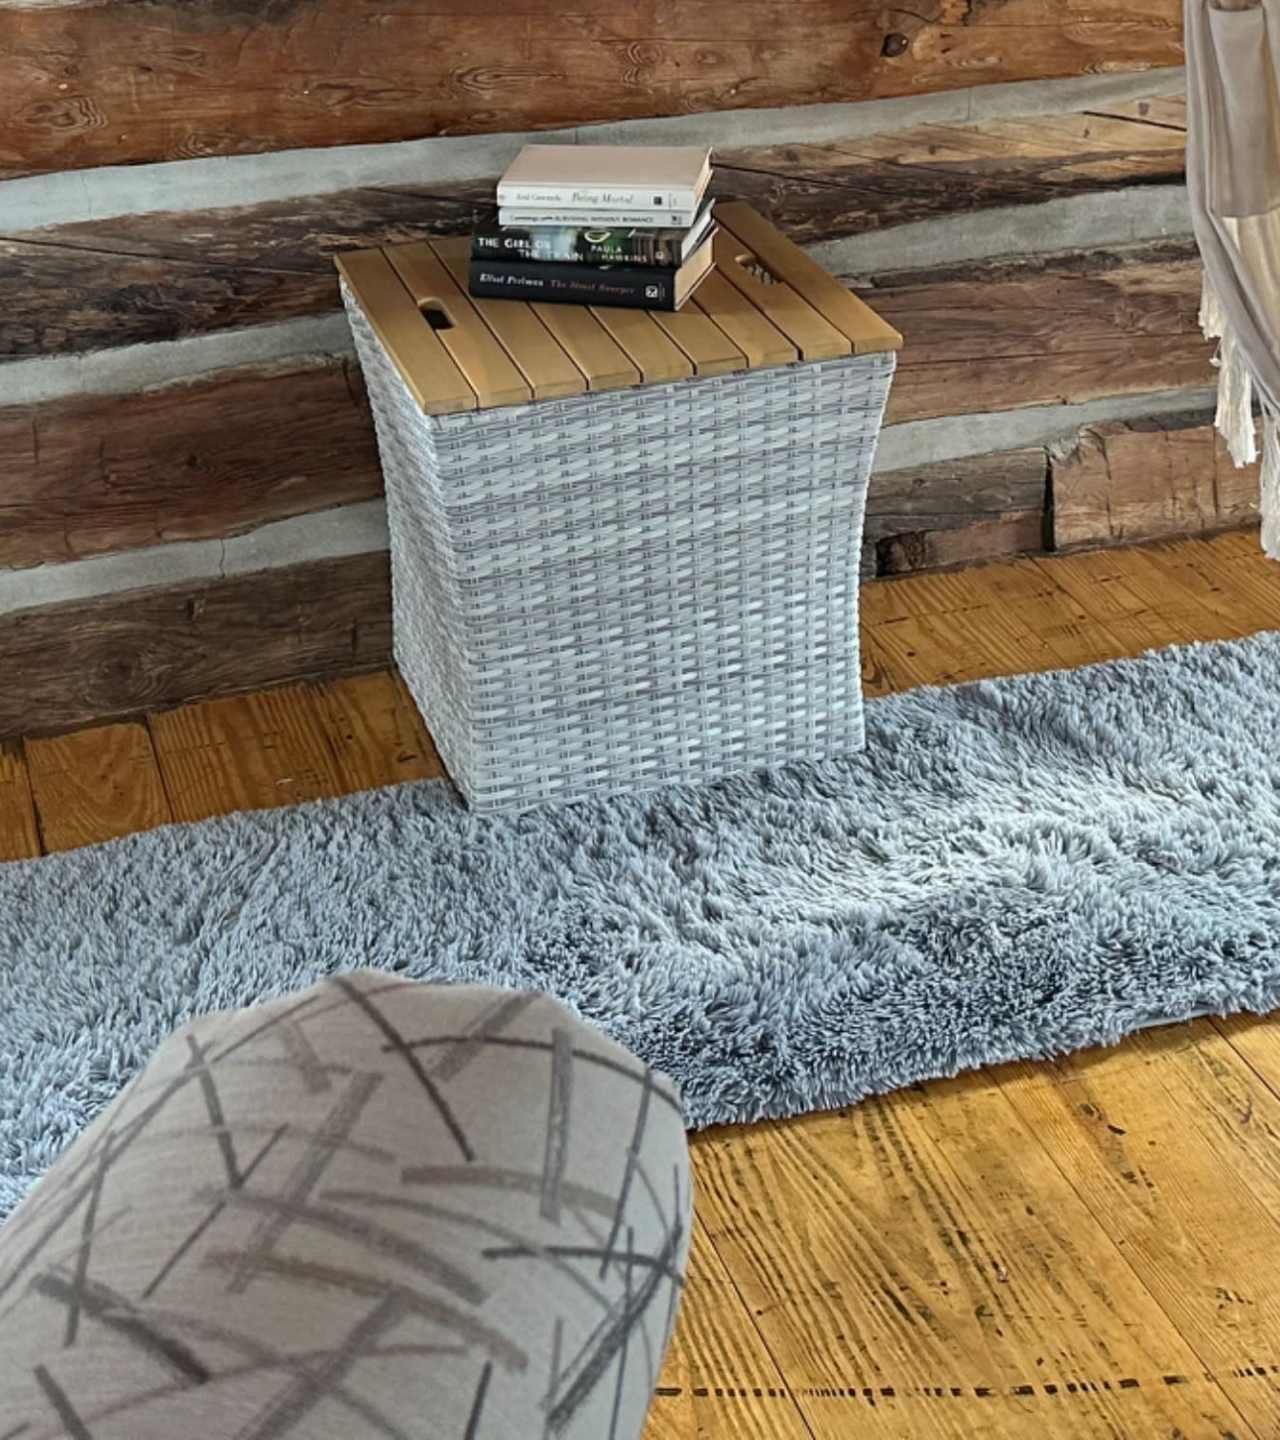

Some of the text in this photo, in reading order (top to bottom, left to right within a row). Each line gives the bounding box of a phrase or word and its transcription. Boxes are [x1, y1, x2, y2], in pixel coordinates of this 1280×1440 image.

[478, 237, 500, 249] THE
[504, 238, 531, 249] GIRL
[590, 244, 623, 253] PAULA
